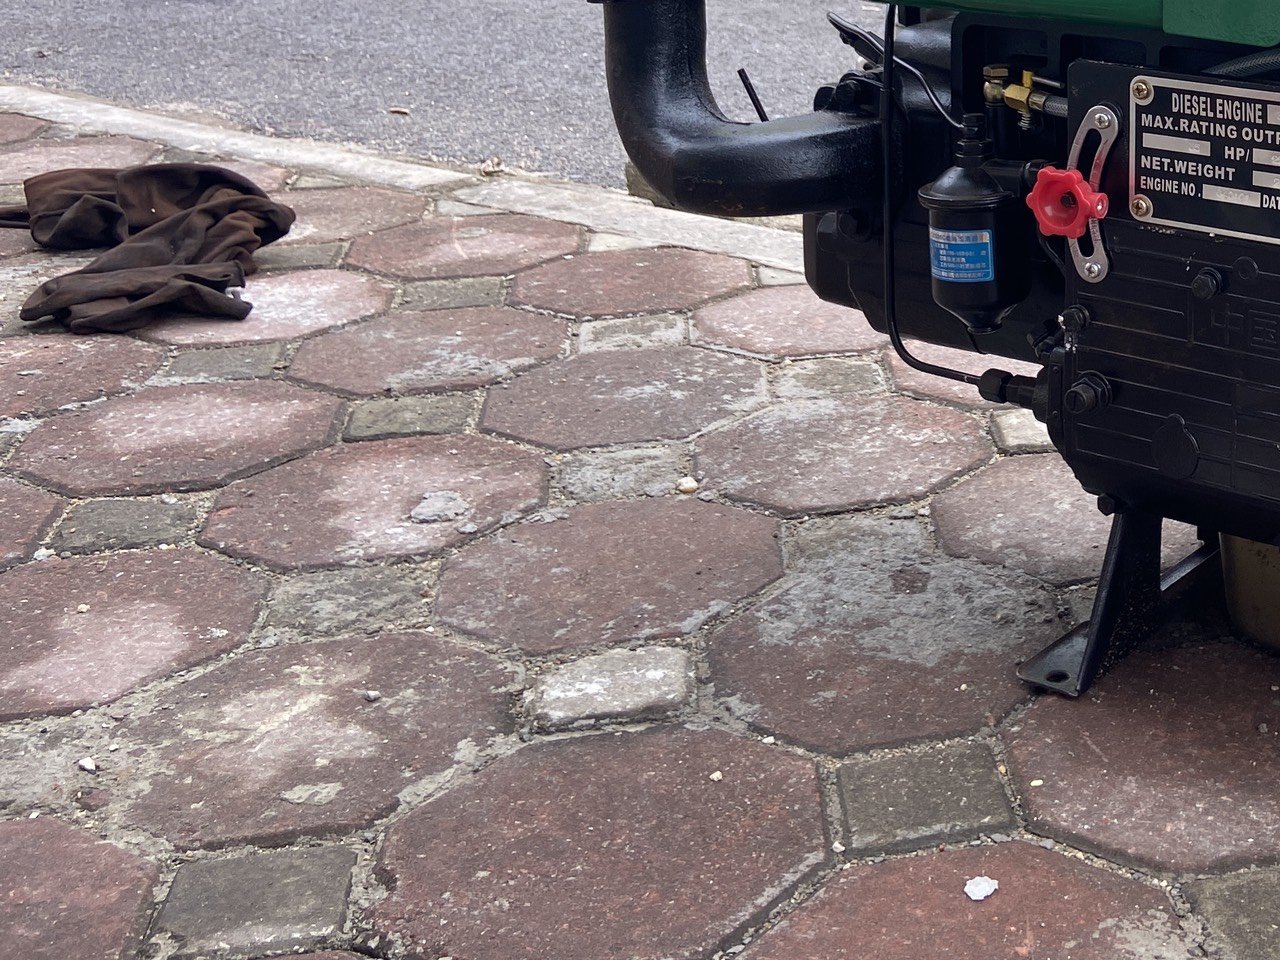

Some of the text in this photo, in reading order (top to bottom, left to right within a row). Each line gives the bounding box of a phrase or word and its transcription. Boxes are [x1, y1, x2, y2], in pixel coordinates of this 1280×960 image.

[1171, 92, 1214, 118] DIESEL
[1216, 98, 1263, 124] ENGINE
[1141, 113, 1238, 139] MAX.RATING
[1140, 154, 1236, 181] NET.WEIGHT
[1224, 146, 1250, 163] HP/
[1140, 175, 1179, 194] ENGINE
